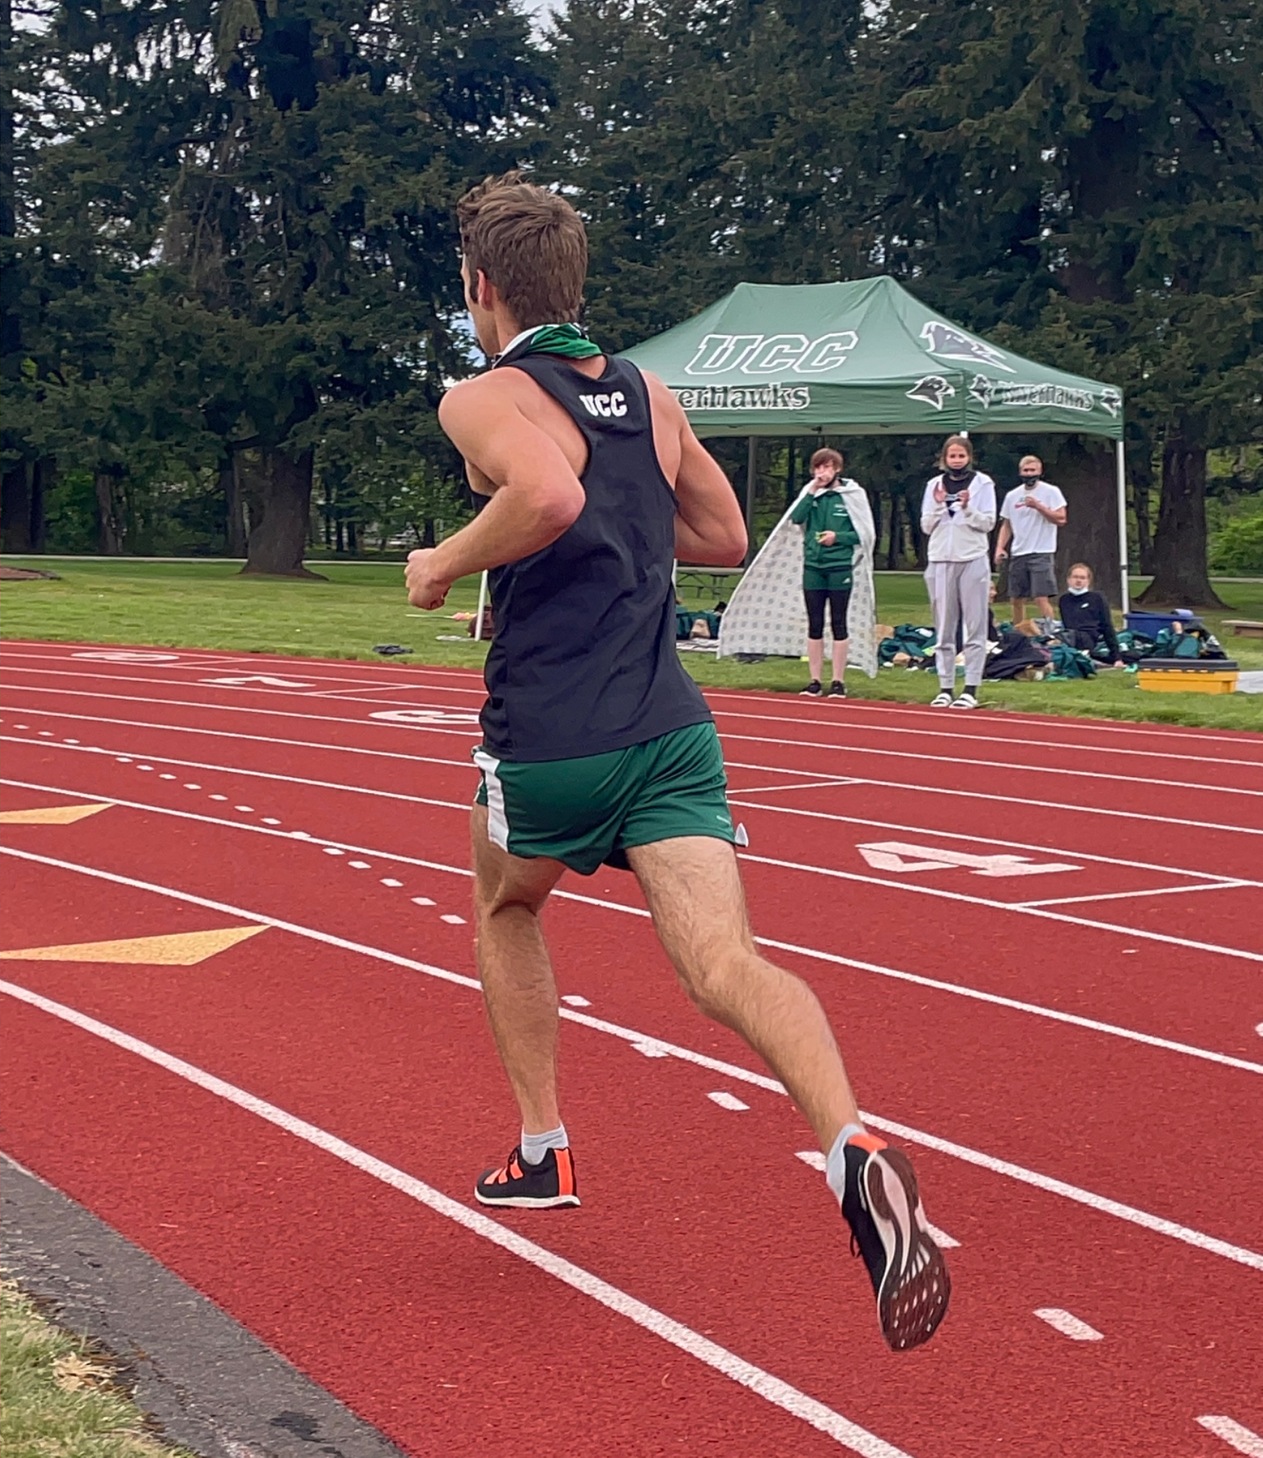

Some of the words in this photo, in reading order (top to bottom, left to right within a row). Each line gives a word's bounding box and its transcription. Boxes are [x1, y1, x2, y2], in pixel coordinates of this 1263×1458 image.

[684, 331, 859, 375] UCC
[578, 391, 628, 417] UCC
[674, 382, 810, 410] erHawks
[854, 841, 1086, 878] 4
